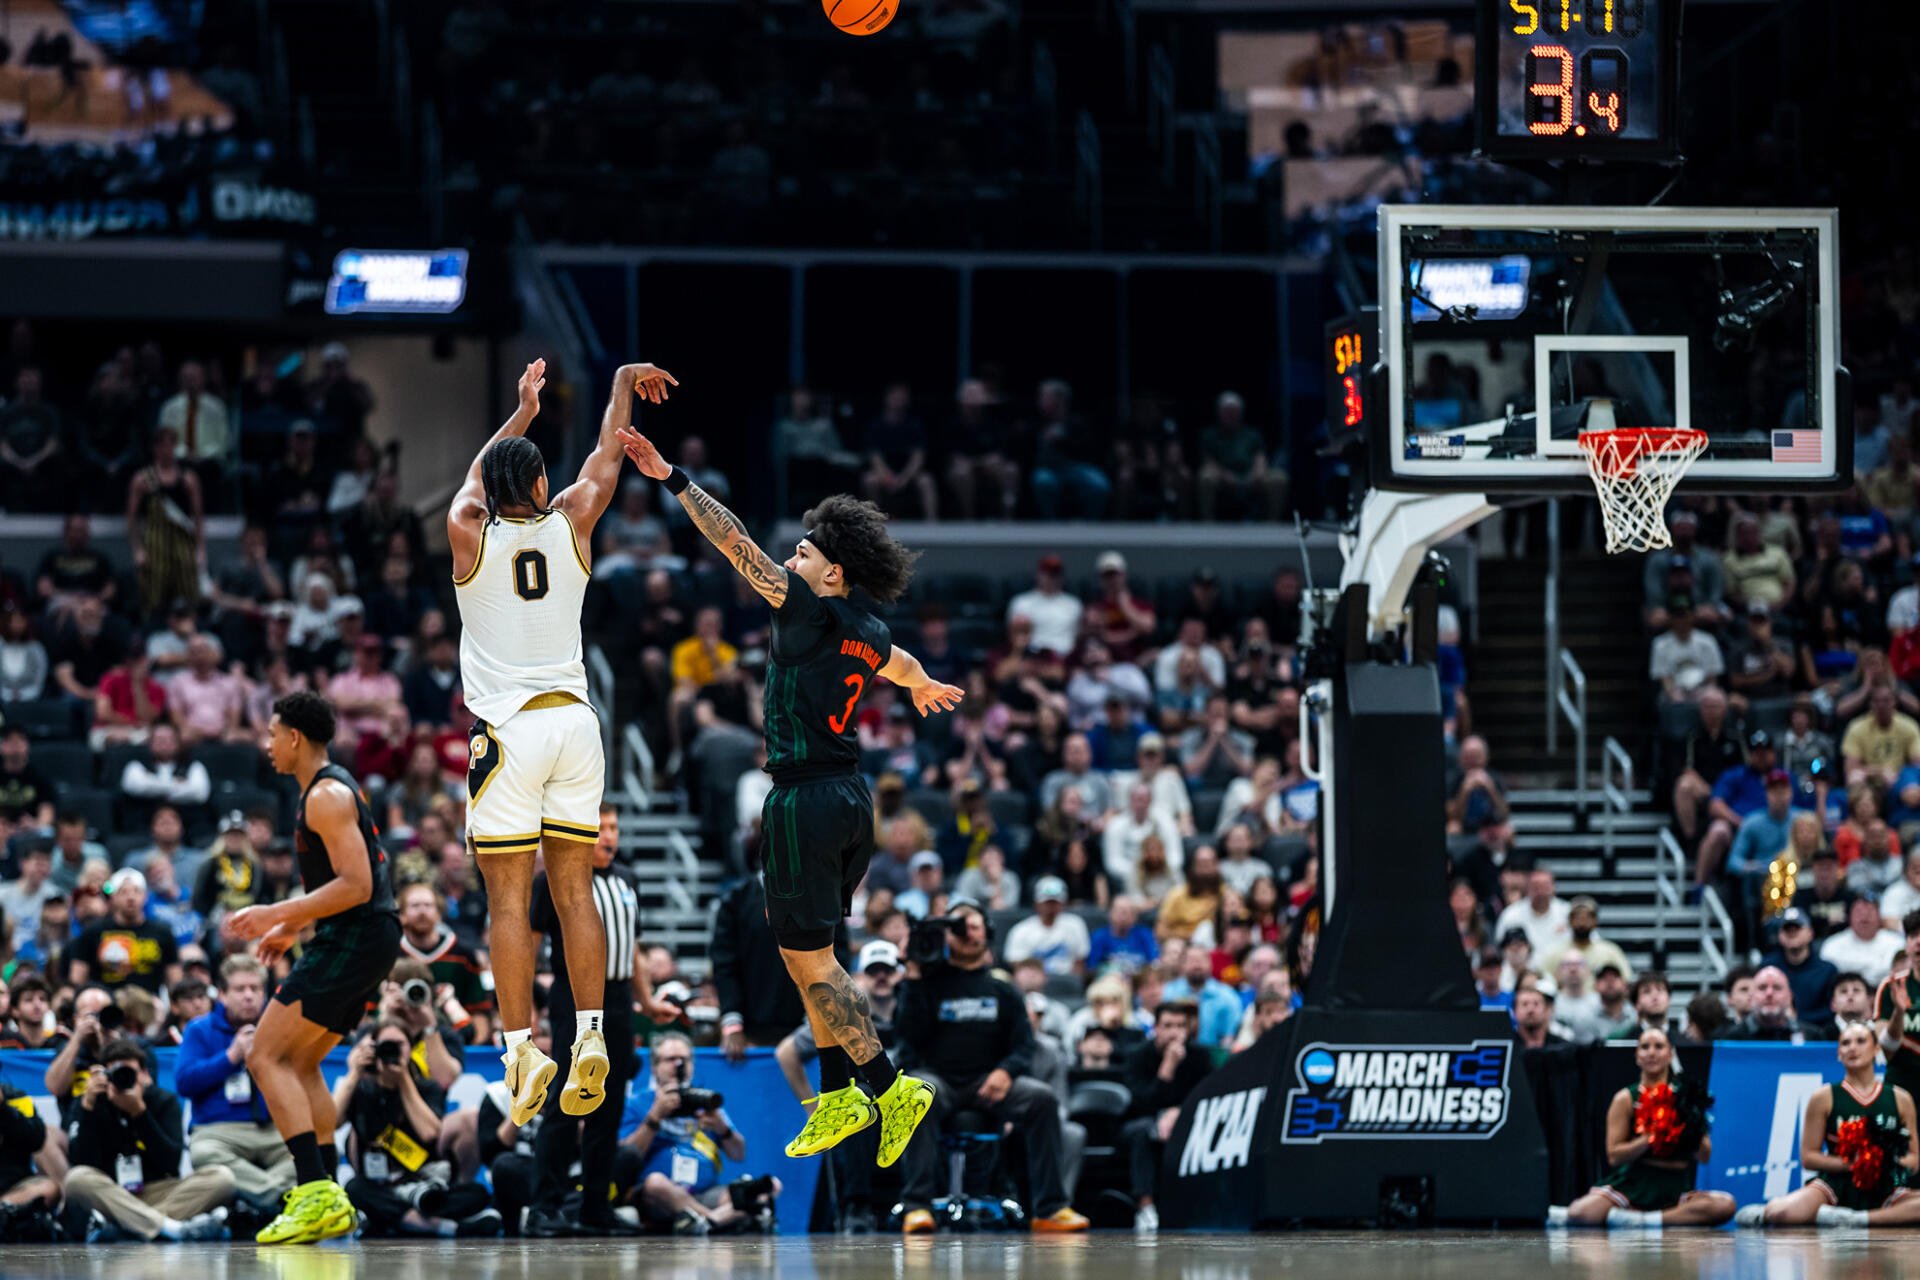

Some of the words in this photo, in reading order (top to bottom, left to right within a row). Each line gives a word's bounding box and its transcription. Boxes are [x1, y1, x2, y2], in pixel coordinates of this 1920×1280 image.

[1529, 44, 1620, 136] 3.4
[512, 548, 549, 601] 0
[828, 673, 865, 734] 3
[1334, 1052, 1450, 1088] MARCH
[1178, 1086, 1268, 1178] NCAA
[1348, 1087, 1504, 1123] MADNESS
